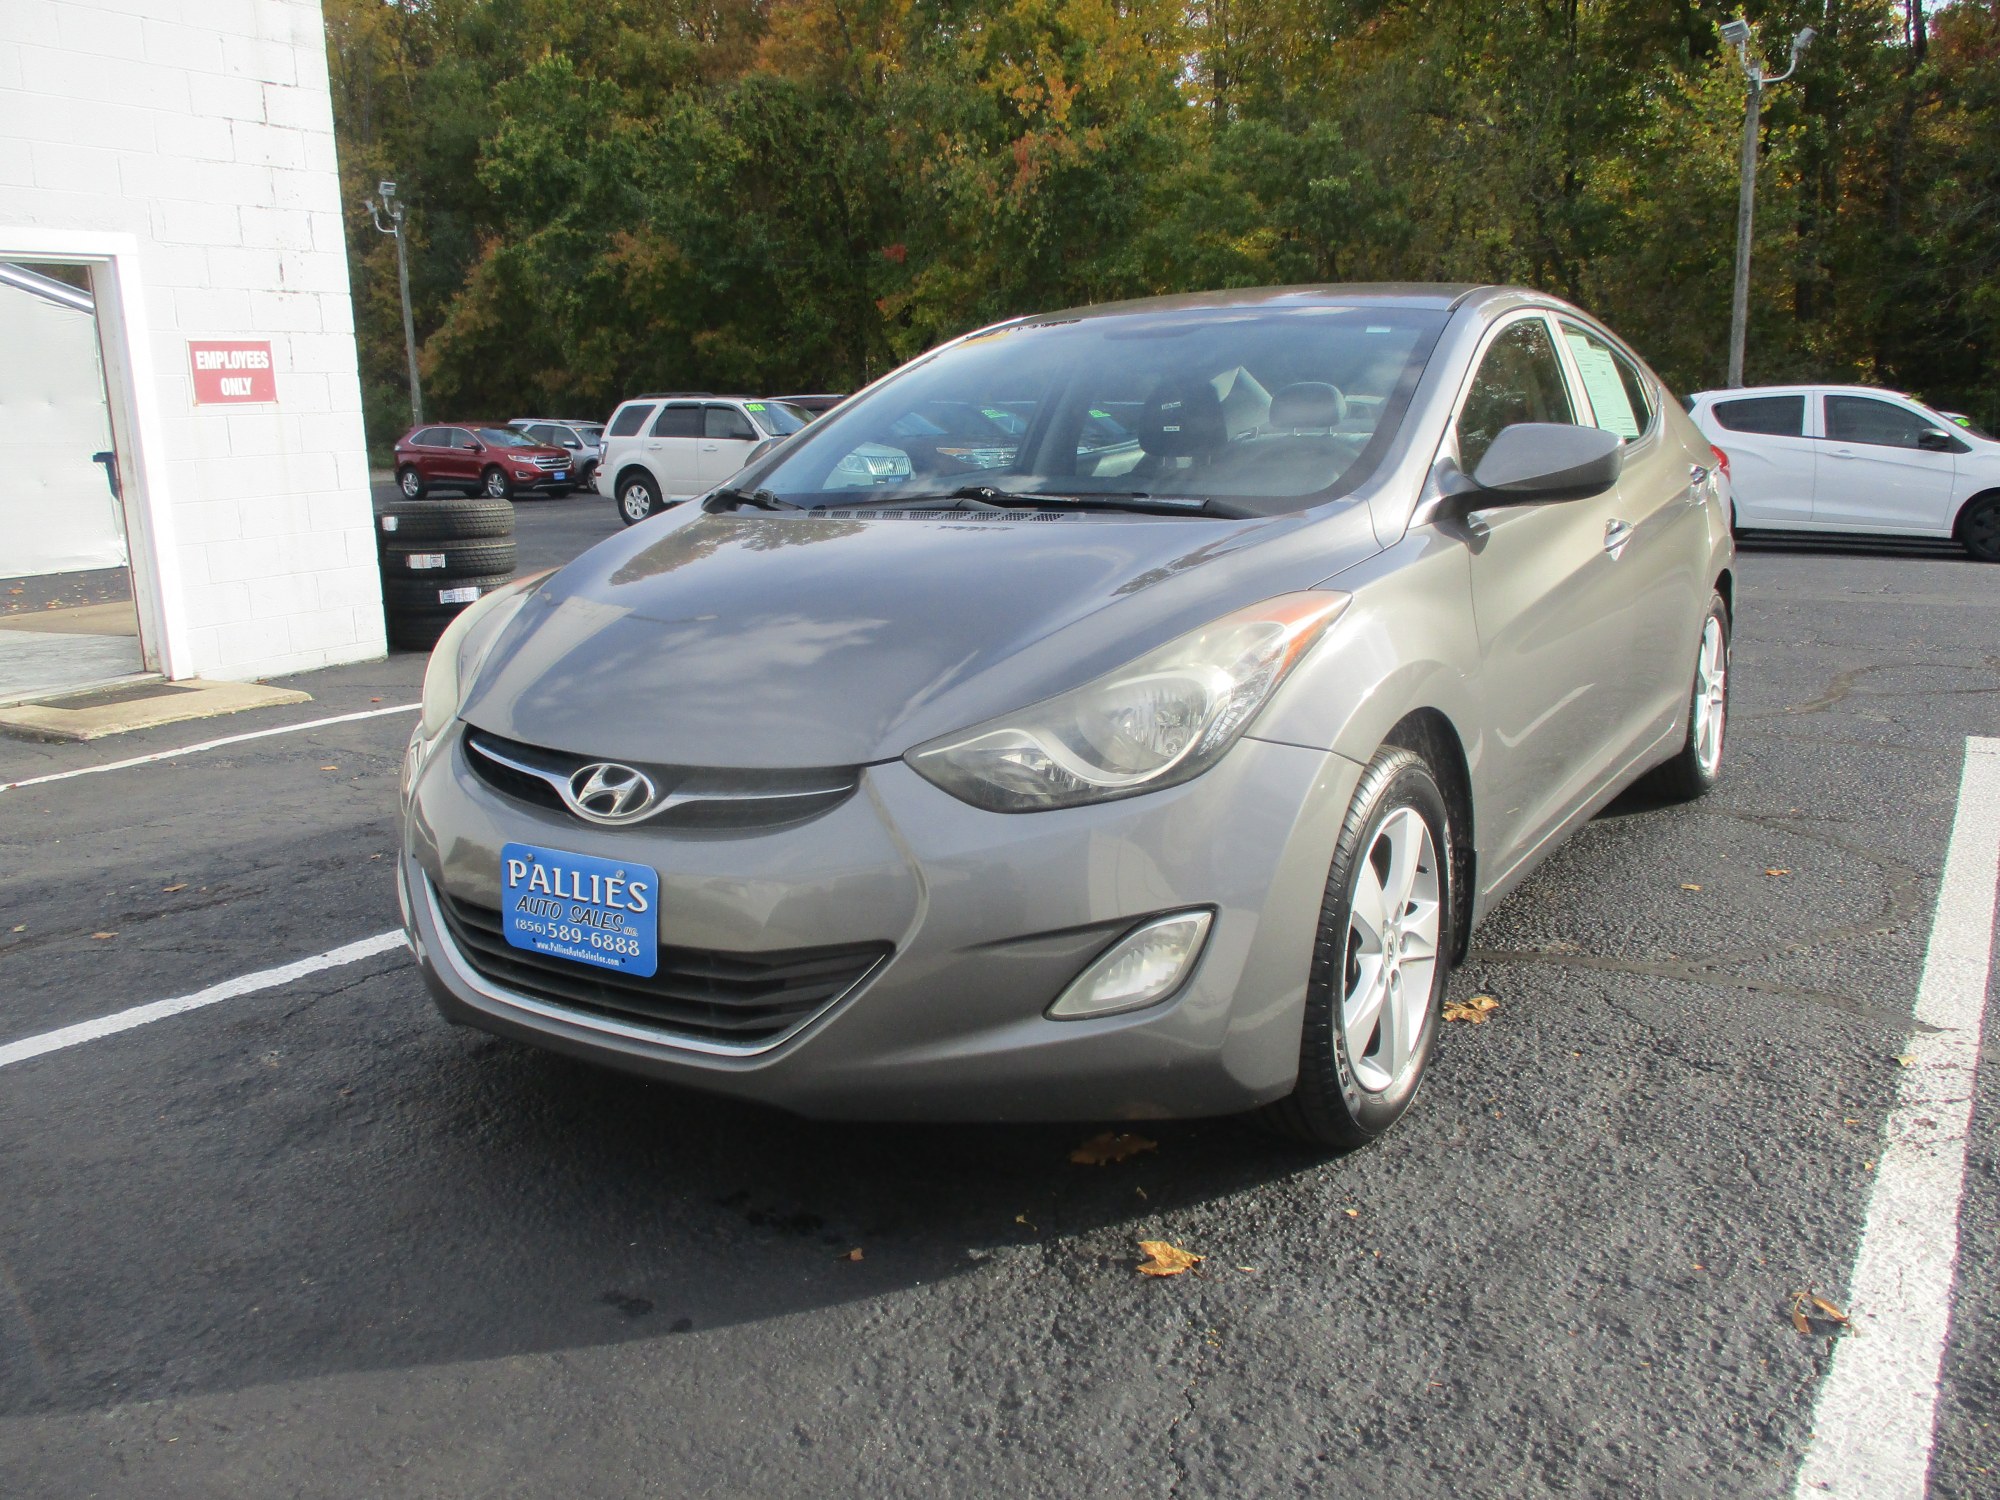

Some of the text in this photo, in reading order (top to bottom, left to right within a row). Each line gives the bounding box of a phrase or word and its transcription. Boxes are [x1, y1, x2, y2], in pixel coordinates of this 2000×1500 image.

[195, 350, 269, 370] EMPLOYEES
[220, 377, 252, 396] ONLY
[507, 859, 648, 913] PALLIES
[515, 895, 562, 920] AUTO
[568, 905, 625, 933] SALES
